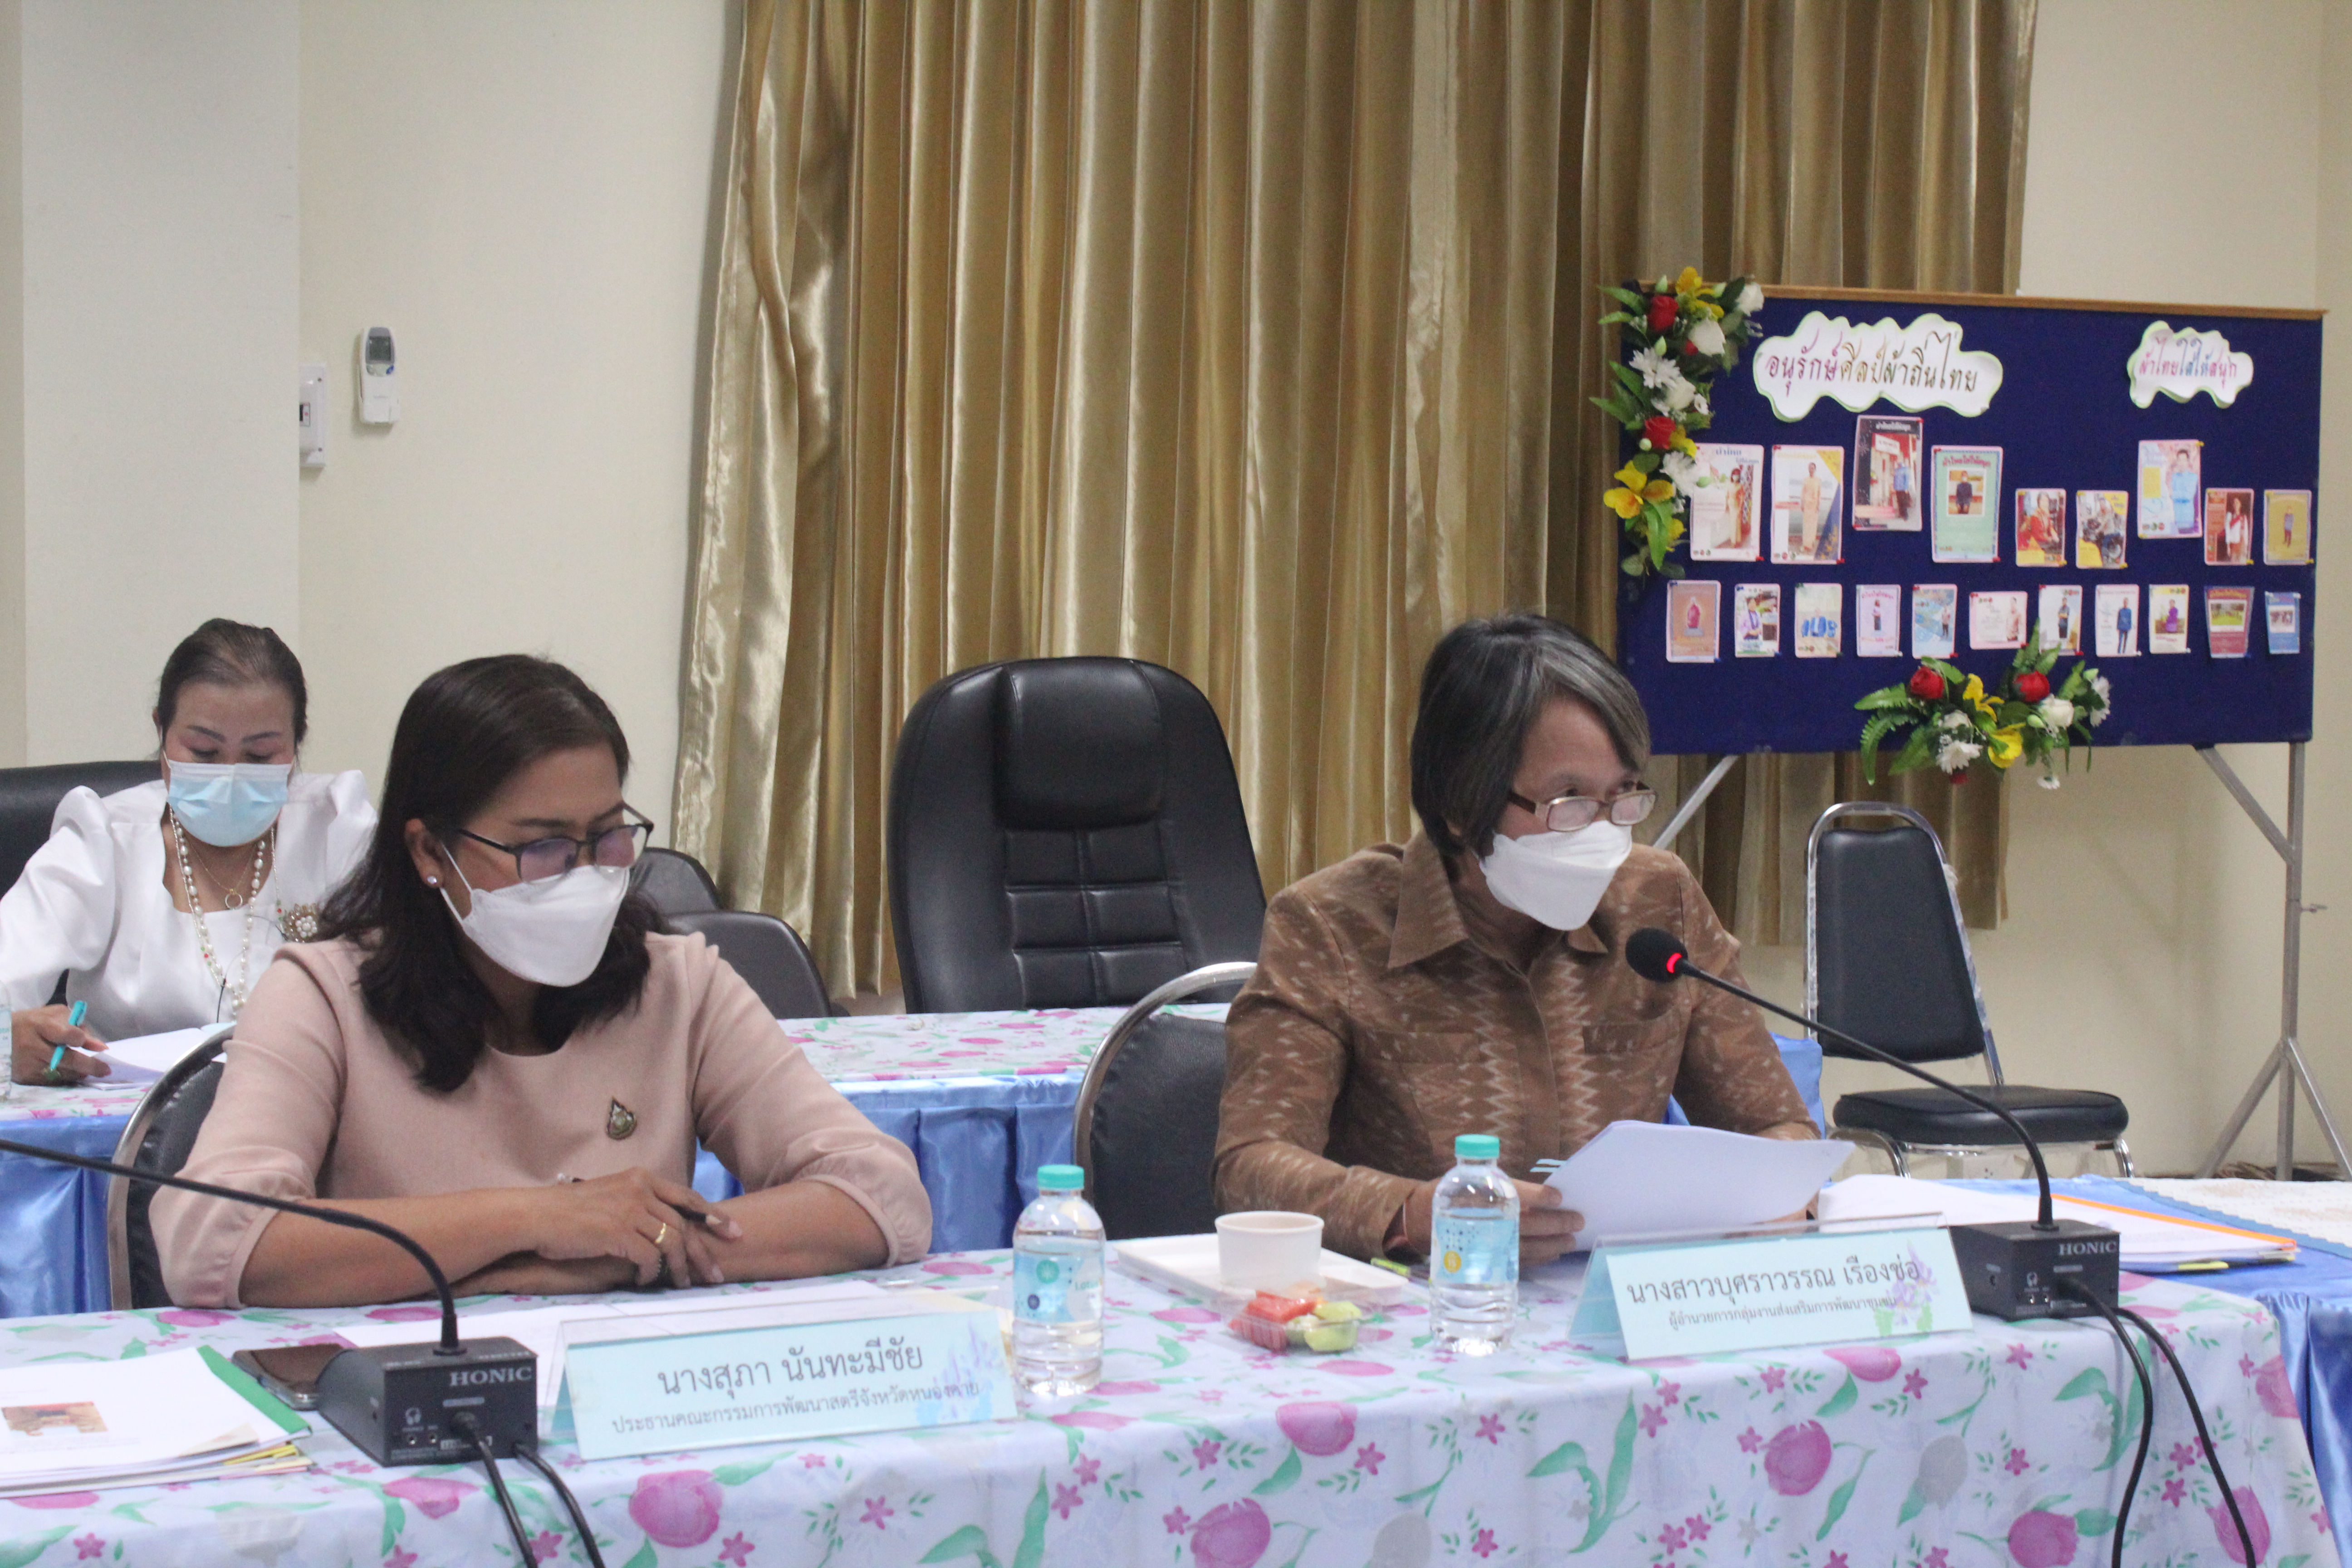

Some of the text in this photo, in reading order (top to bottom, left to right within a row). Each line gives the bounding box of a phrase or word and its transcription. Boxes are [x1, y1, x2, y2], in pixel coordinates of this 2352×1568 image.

[2058, 1241, 2118, 1256] HONIC
[1627, 1268, 1836, 1305] นางสาวบุศราวรรณ
[450, 1366, 533, 1387] HONIC
[657, 1336, 923, 1399] นางสุภา นันทะมีชัย
